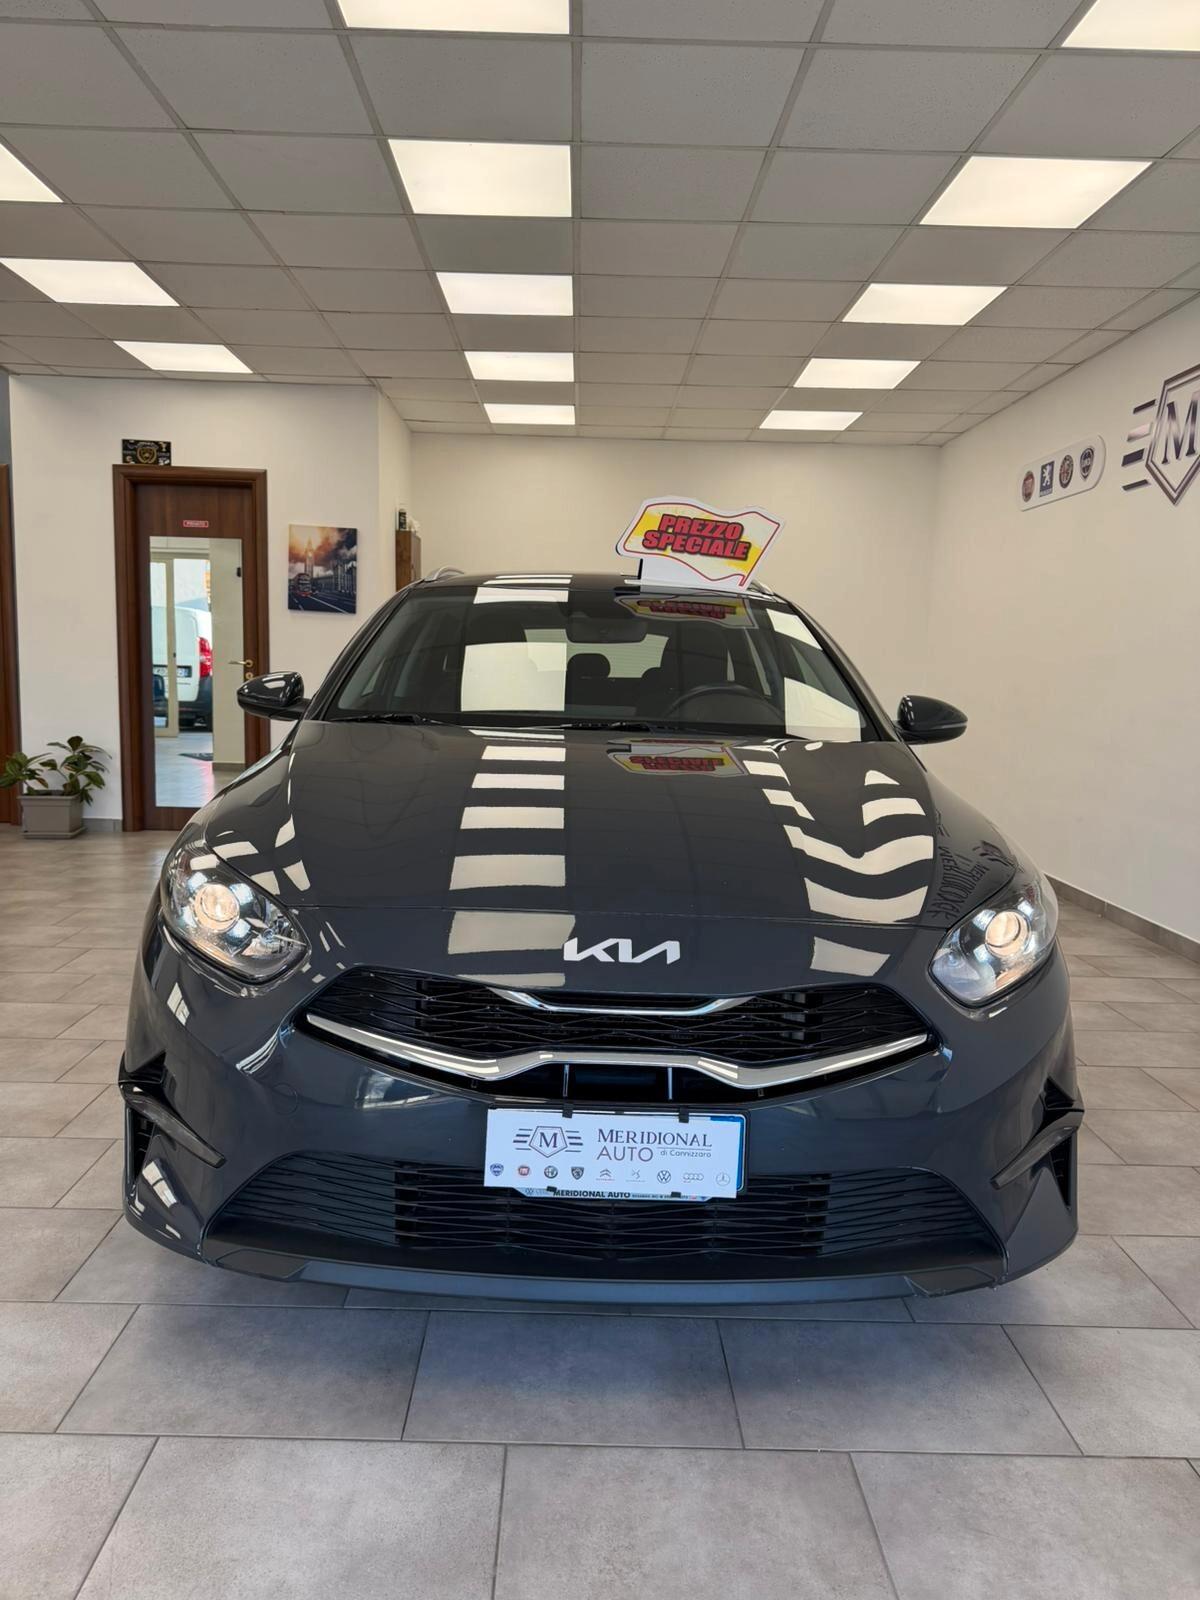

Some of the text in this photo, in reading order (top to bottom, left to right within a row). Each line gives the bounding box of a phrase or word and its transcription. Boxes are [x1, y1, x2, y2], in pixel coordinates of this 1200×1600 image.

[1162, 392, 1200, 465] M
[658, 514, 744, 541] PREZZO
[642, 530, 752, 561] SPECIALE
[563, 937, 681, 965] KIA
[539, 1132, 558, 1148] M
[598, 1128, 713, 1147] MERIDIONAL
[596, 1145, 654, 1163] AUTO
[553, 1189, 606, 1198] MERIDIONAL
[608, 1190, 631, 1199] AUTO
